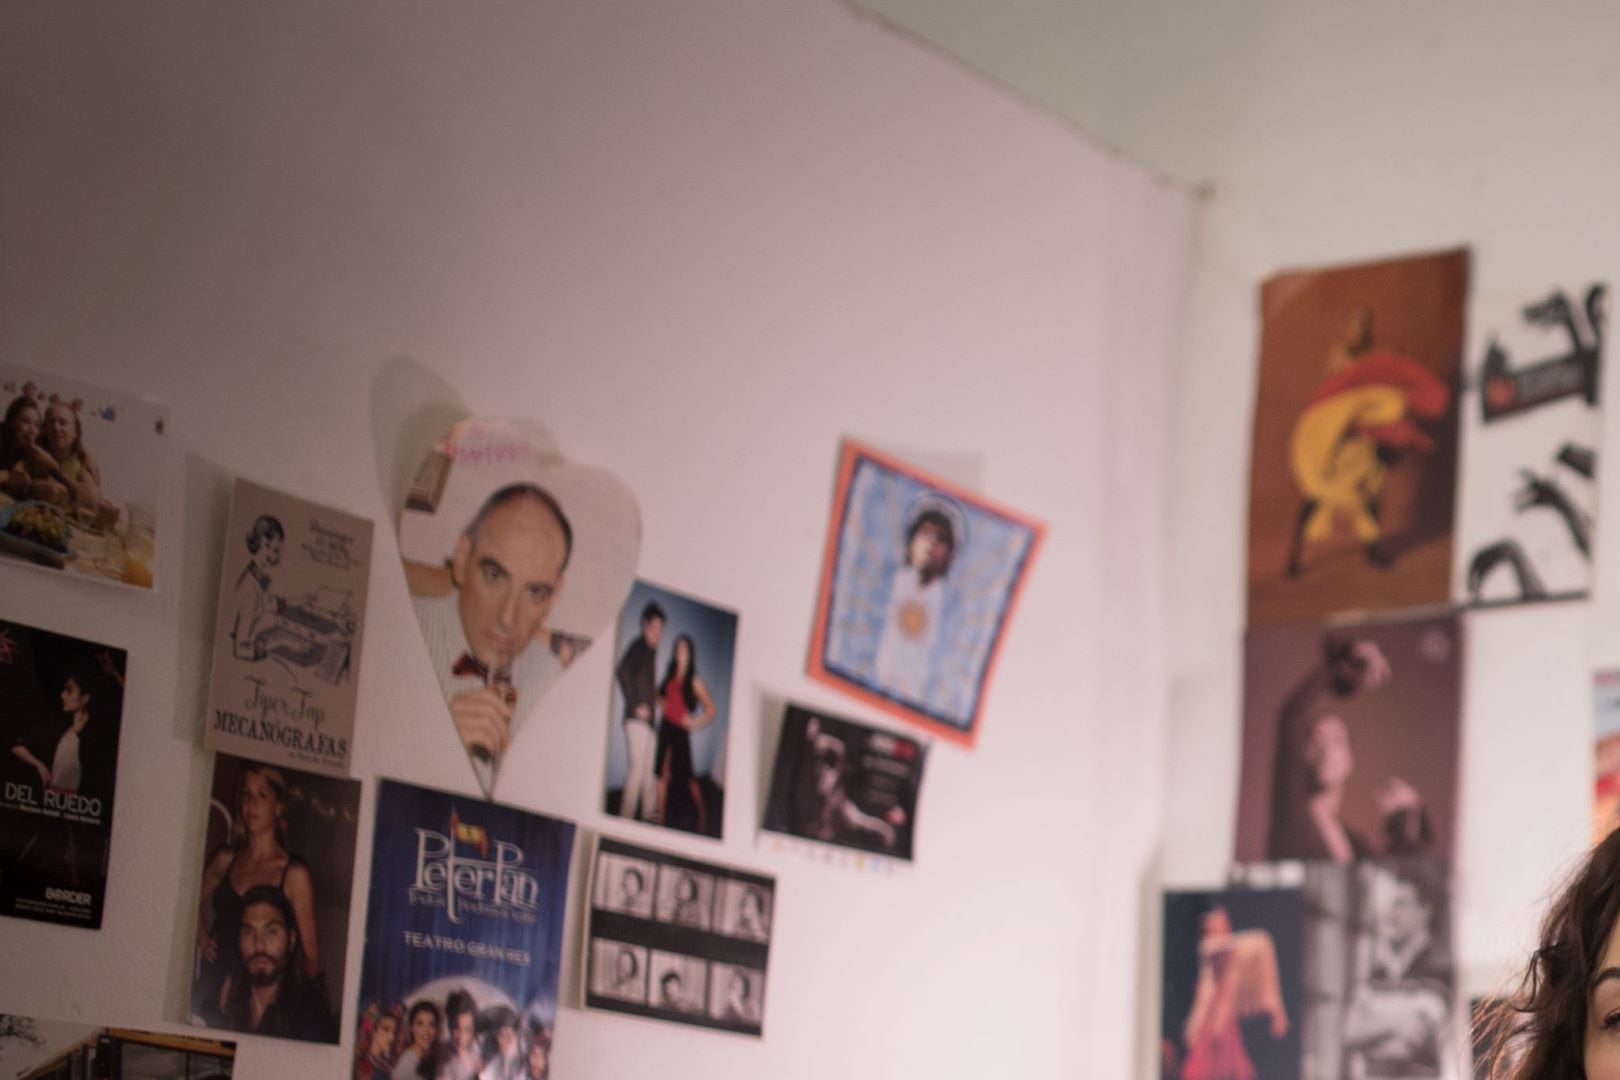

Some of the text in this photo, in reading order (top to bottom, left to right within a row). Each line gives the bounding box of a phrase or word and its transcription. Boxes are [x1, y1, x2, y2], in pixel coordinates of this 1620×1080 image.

[5, 782, 37, 805] DEL
[44, 789, 101, 817] RUEDO
[415, 826, 496, 924] Peter
[494, 839, 539, 910] Pan
[403, 930, 531, 966] TEATRO GRAN REX
